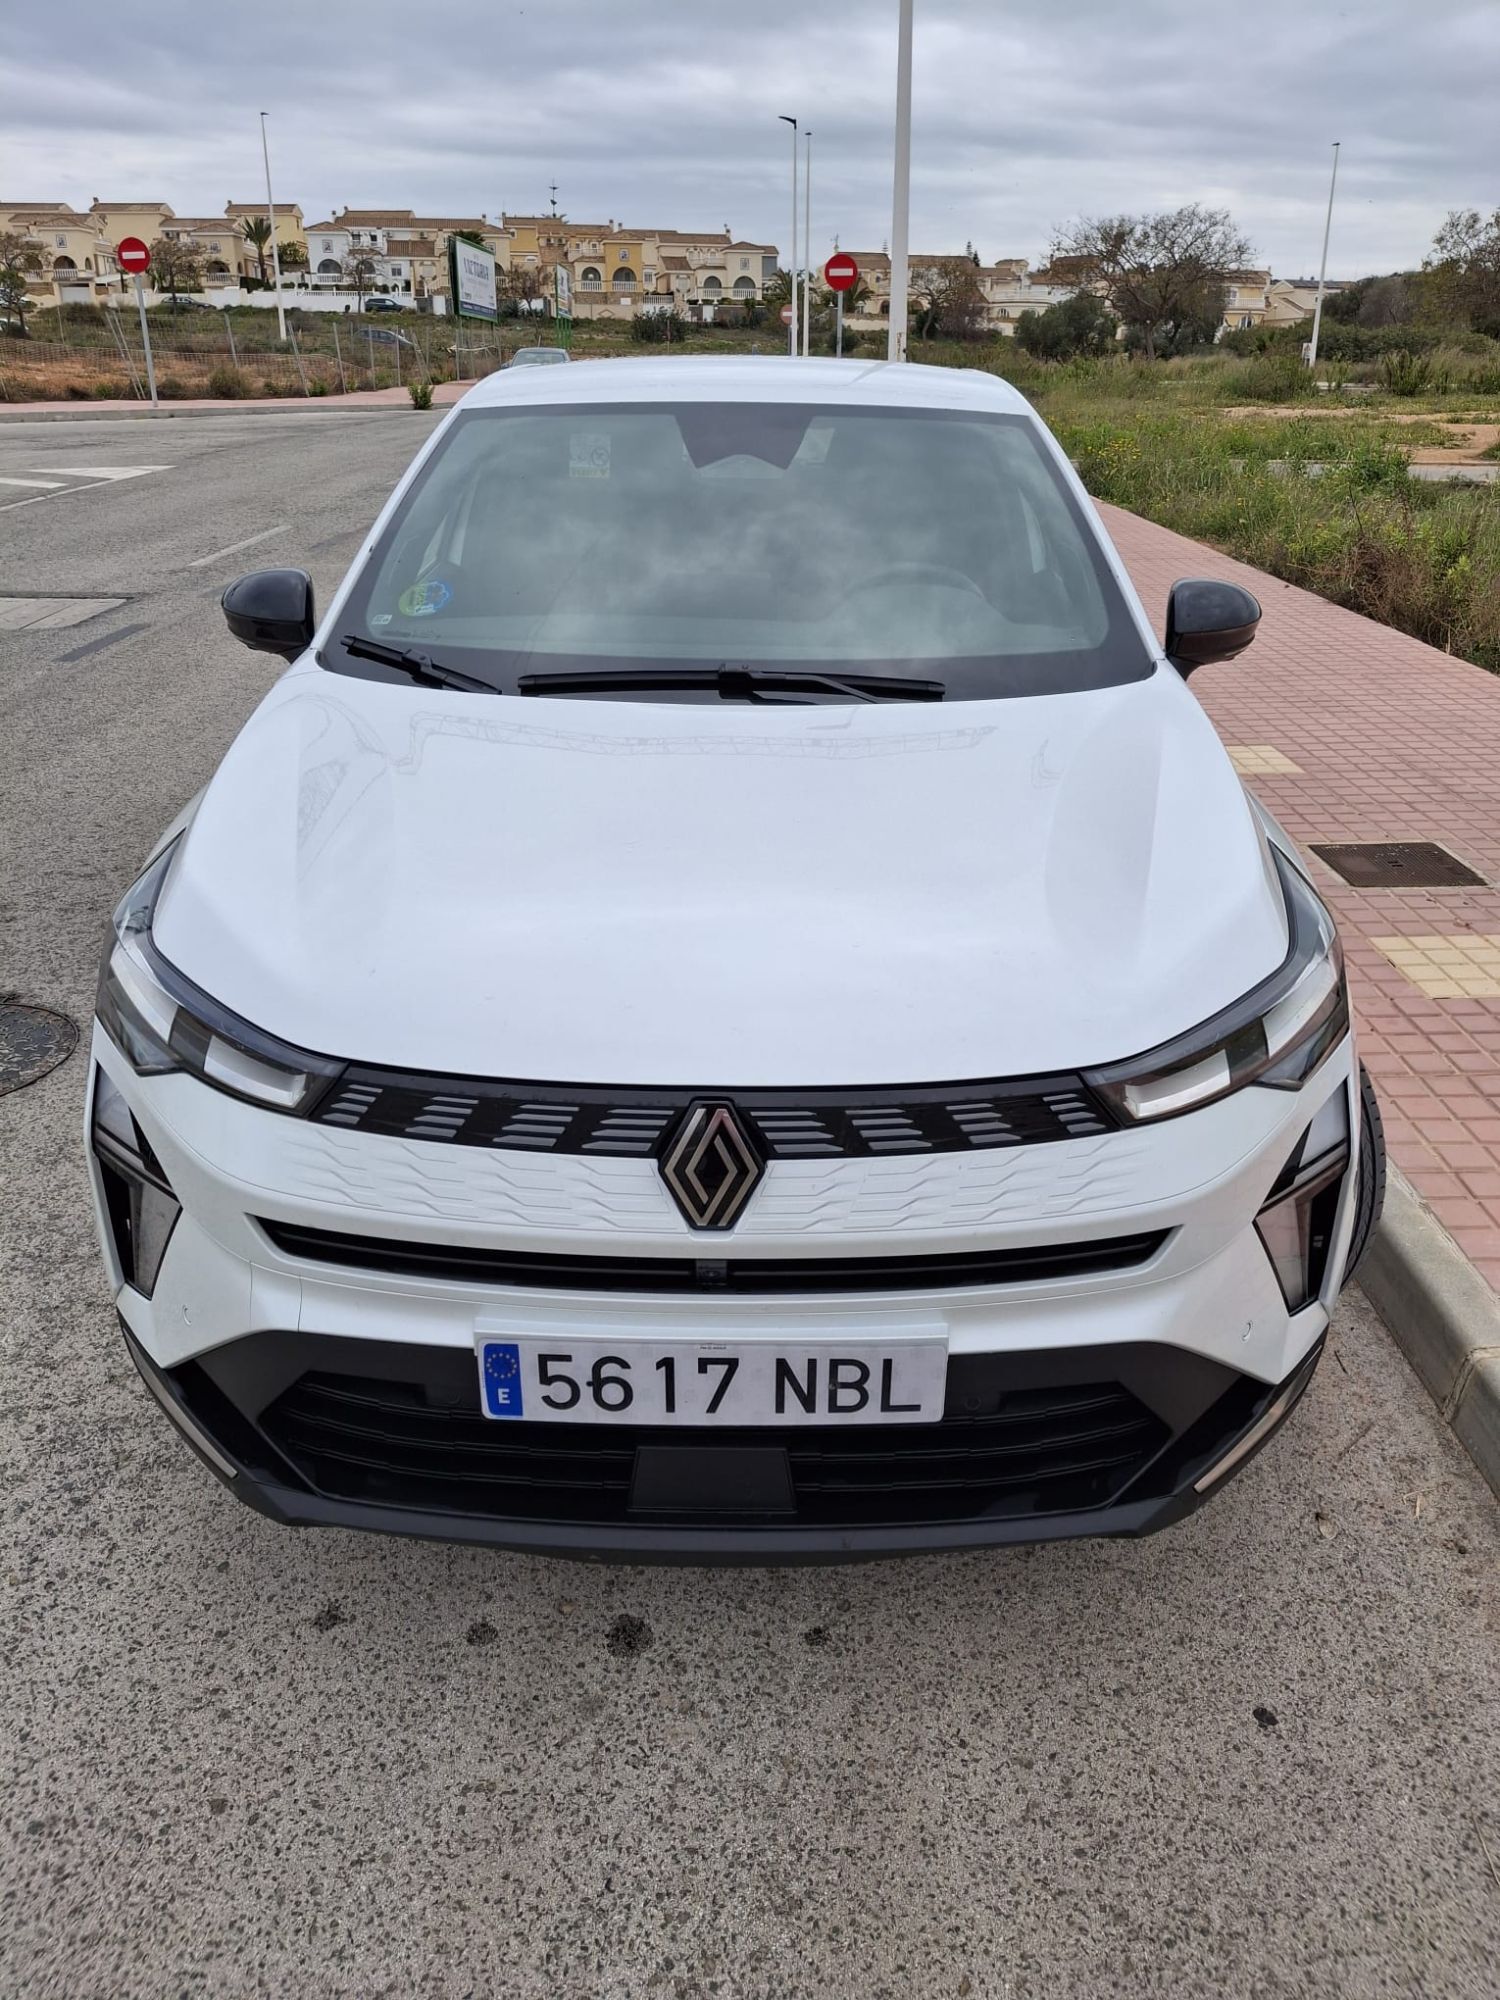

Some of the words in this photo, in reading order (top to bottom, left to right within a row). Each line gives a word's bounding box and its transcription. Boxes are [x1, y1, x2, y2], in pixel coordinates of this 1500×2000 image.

[497, 1388, 511, 1404] E
[538, 1353, 740, 1413] 5617
[775, 1357, 922, 1414] NBL
